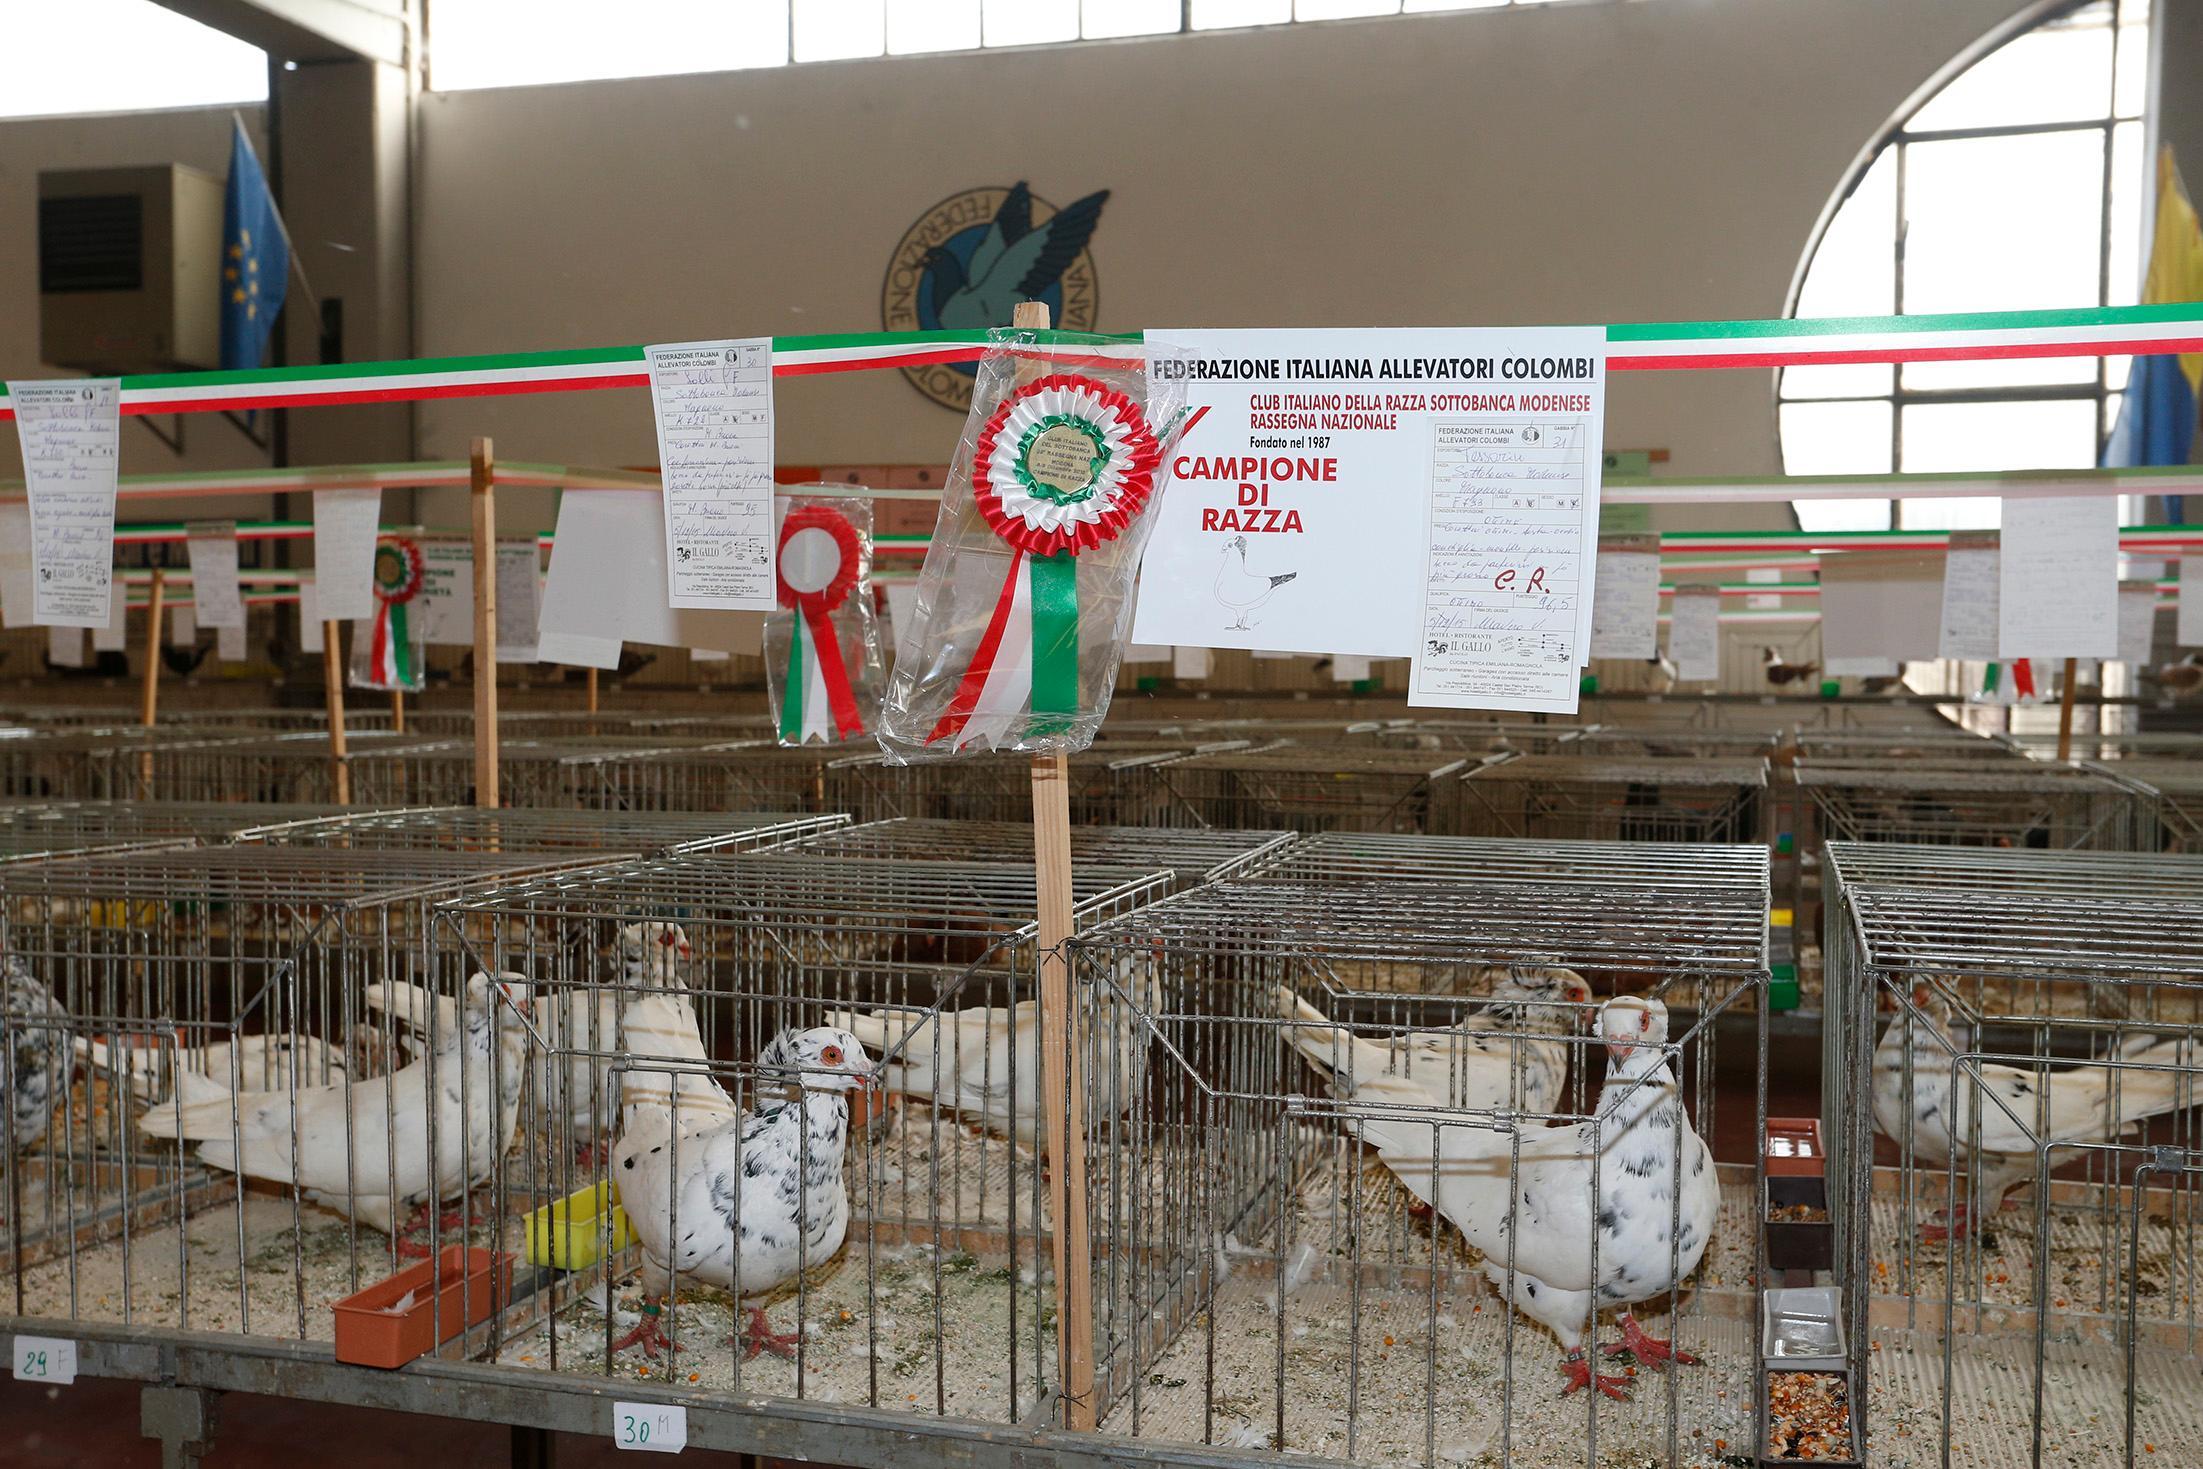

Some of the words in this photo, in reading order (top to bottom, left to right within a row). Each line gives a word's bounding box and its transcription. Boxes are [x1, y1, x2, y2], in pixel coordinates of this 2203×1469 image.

[655, 352, 695, 361] FEDERAZIONE
[695, 351, 720, 359] ITALIANA
[657, 360, 692, 369] ALLEVATORI
[1153, 358, 1280, 380] FEDERAZIONE
[1286, 358, 1374, 379] ITALIANA
[1379, 357, 1494, 379] ALLEVATORI
[1501, 357, 1594, 379] COLOMBI
[1250, 394, 1281, 411] CLUB
[1284, 394, 1340, 411] ITALIANO
[1345, 394, 1382, 411] DELLA
[1385, 394, 1427, 411] RAZZA
[1430, 394, 1516, 412] SOTTOBANCA
[1519, 394, 1591, 412] MODENESE
[1250, 413, 1318, 430] RASSEGNA
[1321, 413, 1397, 430] NAZIONALE
[1438, 427, 1483, 435] FEDERAZIONE
[1484, 427, 1514, 435] ITALIANA
[1062, 438, 1088, 447] ITALIANO
[1250, 436, 1287, 449] Fondato
[1290, 435, 1304, 449] nel
[1307, 436, 1331, 449] 1987
[1438, 436, 1478, 444] ALLEVATORI
[1053, 443, 1090, 454] SOTTOBANCA
[1172, 455, 1338, 482] CAMPIONE
[1237, 482, 1269, 507] DI
[1202, 508, 1304, 533] RAZZA
[699, 547, 720, 557] GALLO
[1450, 640, 1461, 651] IL
[1461, 641, 1492, 653] GALLO
[23, 1350, 48, 1377] 29
[623, 1415, 650, 1444] 30
